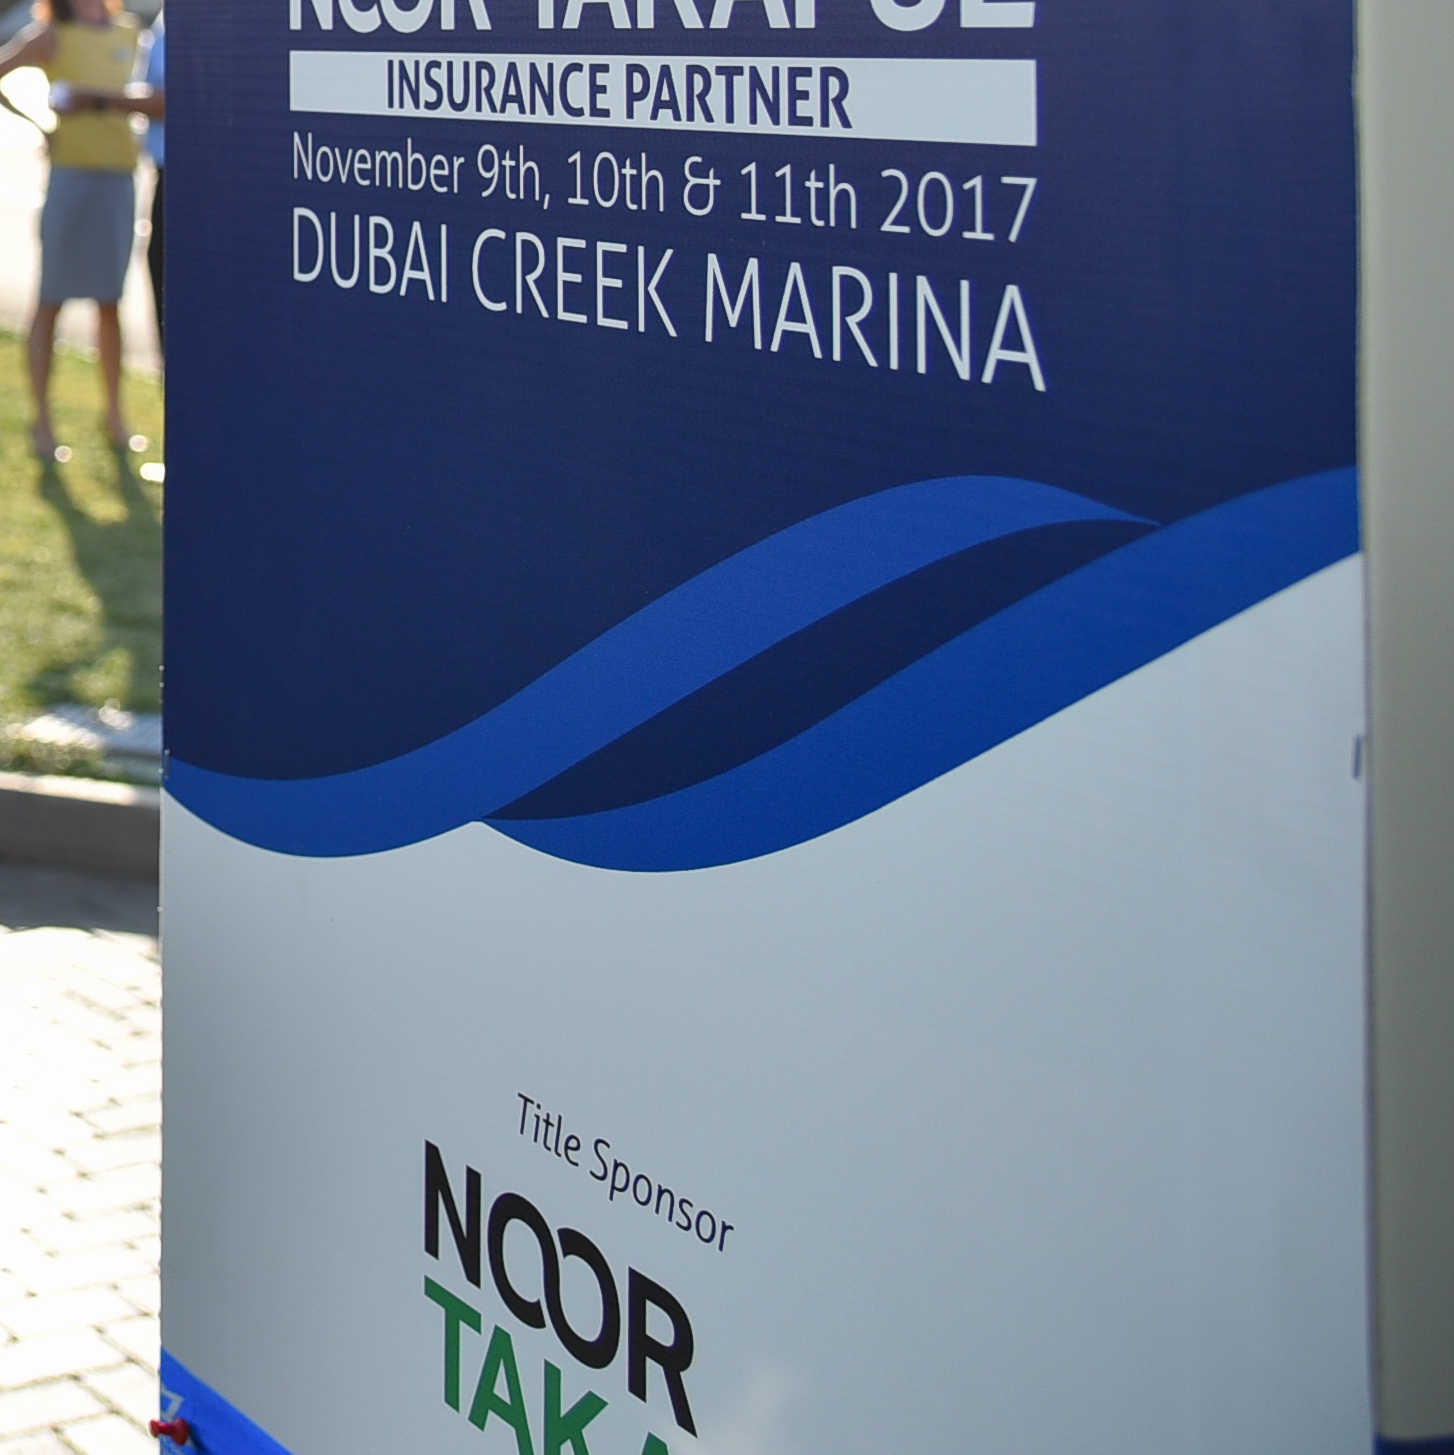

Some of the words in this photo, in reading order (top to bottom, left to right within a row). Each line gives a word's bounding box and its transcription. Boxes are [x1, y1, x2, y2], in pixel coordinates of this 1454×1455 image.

[387, 59, 611, 120] INSURANCE
[625, 63, 853, 129] PARTNER
[293, 131, 465, 195] November
[477, 143, 551, 211] 9th,
[568, 150, 665, 213] 10th
[683, 155, 722, 216] &
[740, 161, 857, 229] 11th
[880, 168, 1038, 243] 2017
[293, 207, 448, 303] DUBAI
[471, 228, 678, 339] CREEK
[705, 252, 1047, 392] MARINA
[517, 1092, 581, 1168] Title
[589, 1137, 735, 1252] Sponsor
[424, 1139, 699, 1439] NOOR
[424, 1274, 670, 1455] TAK
